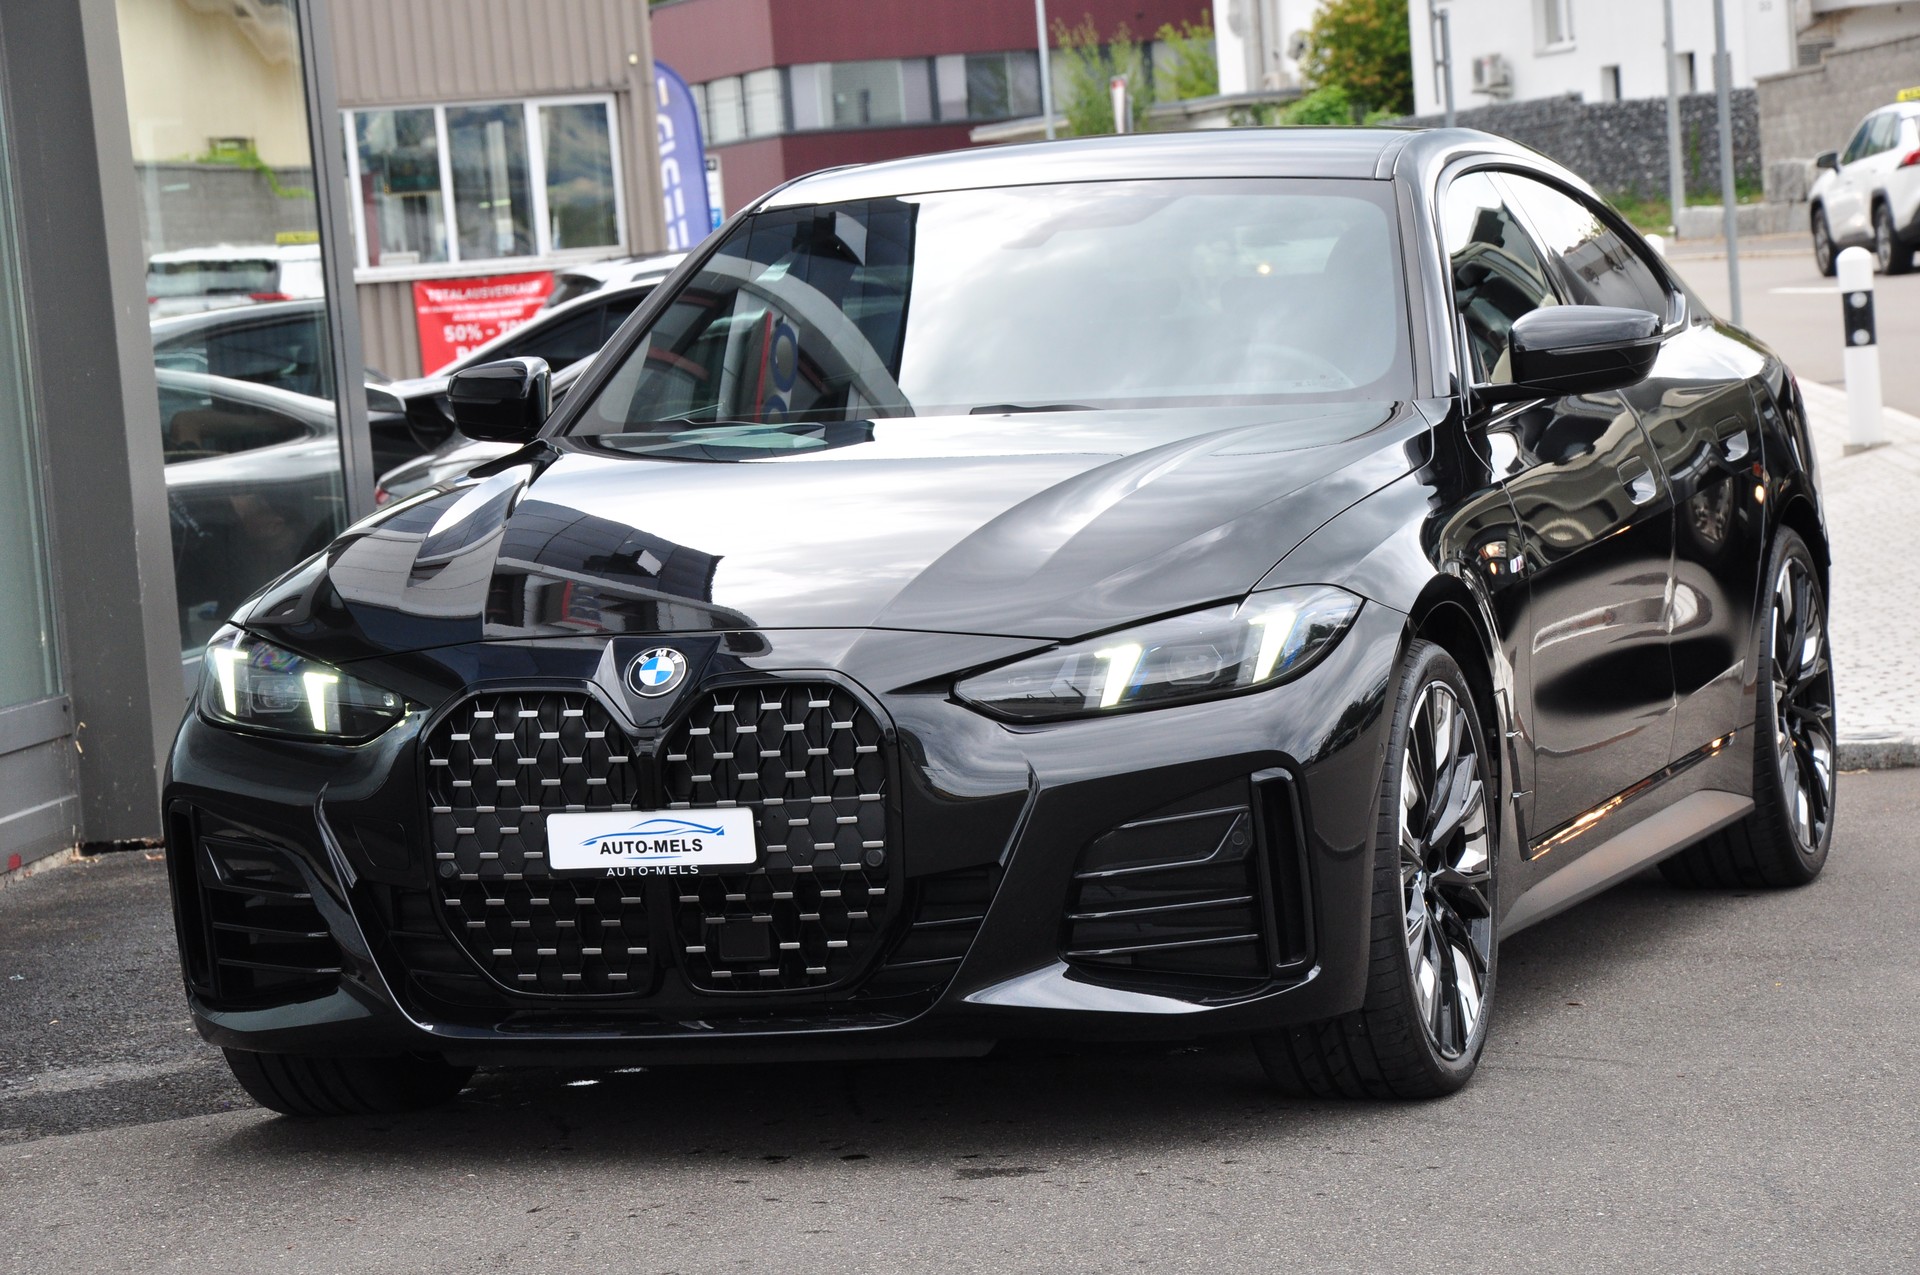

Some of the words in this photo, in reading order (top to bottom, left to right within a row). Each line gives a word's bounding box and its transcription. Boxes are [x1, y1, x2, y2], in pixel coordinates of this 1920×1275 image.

[426, 280, 542, 302] TOTALAUSVERKAUF
[443, 323, 483, 343] 50%
[638, 649, 683, 665] BMW
[599, 838, 703, 855] AUTO-MELS
[606, 864, 700, 877] AUTO-MELS
